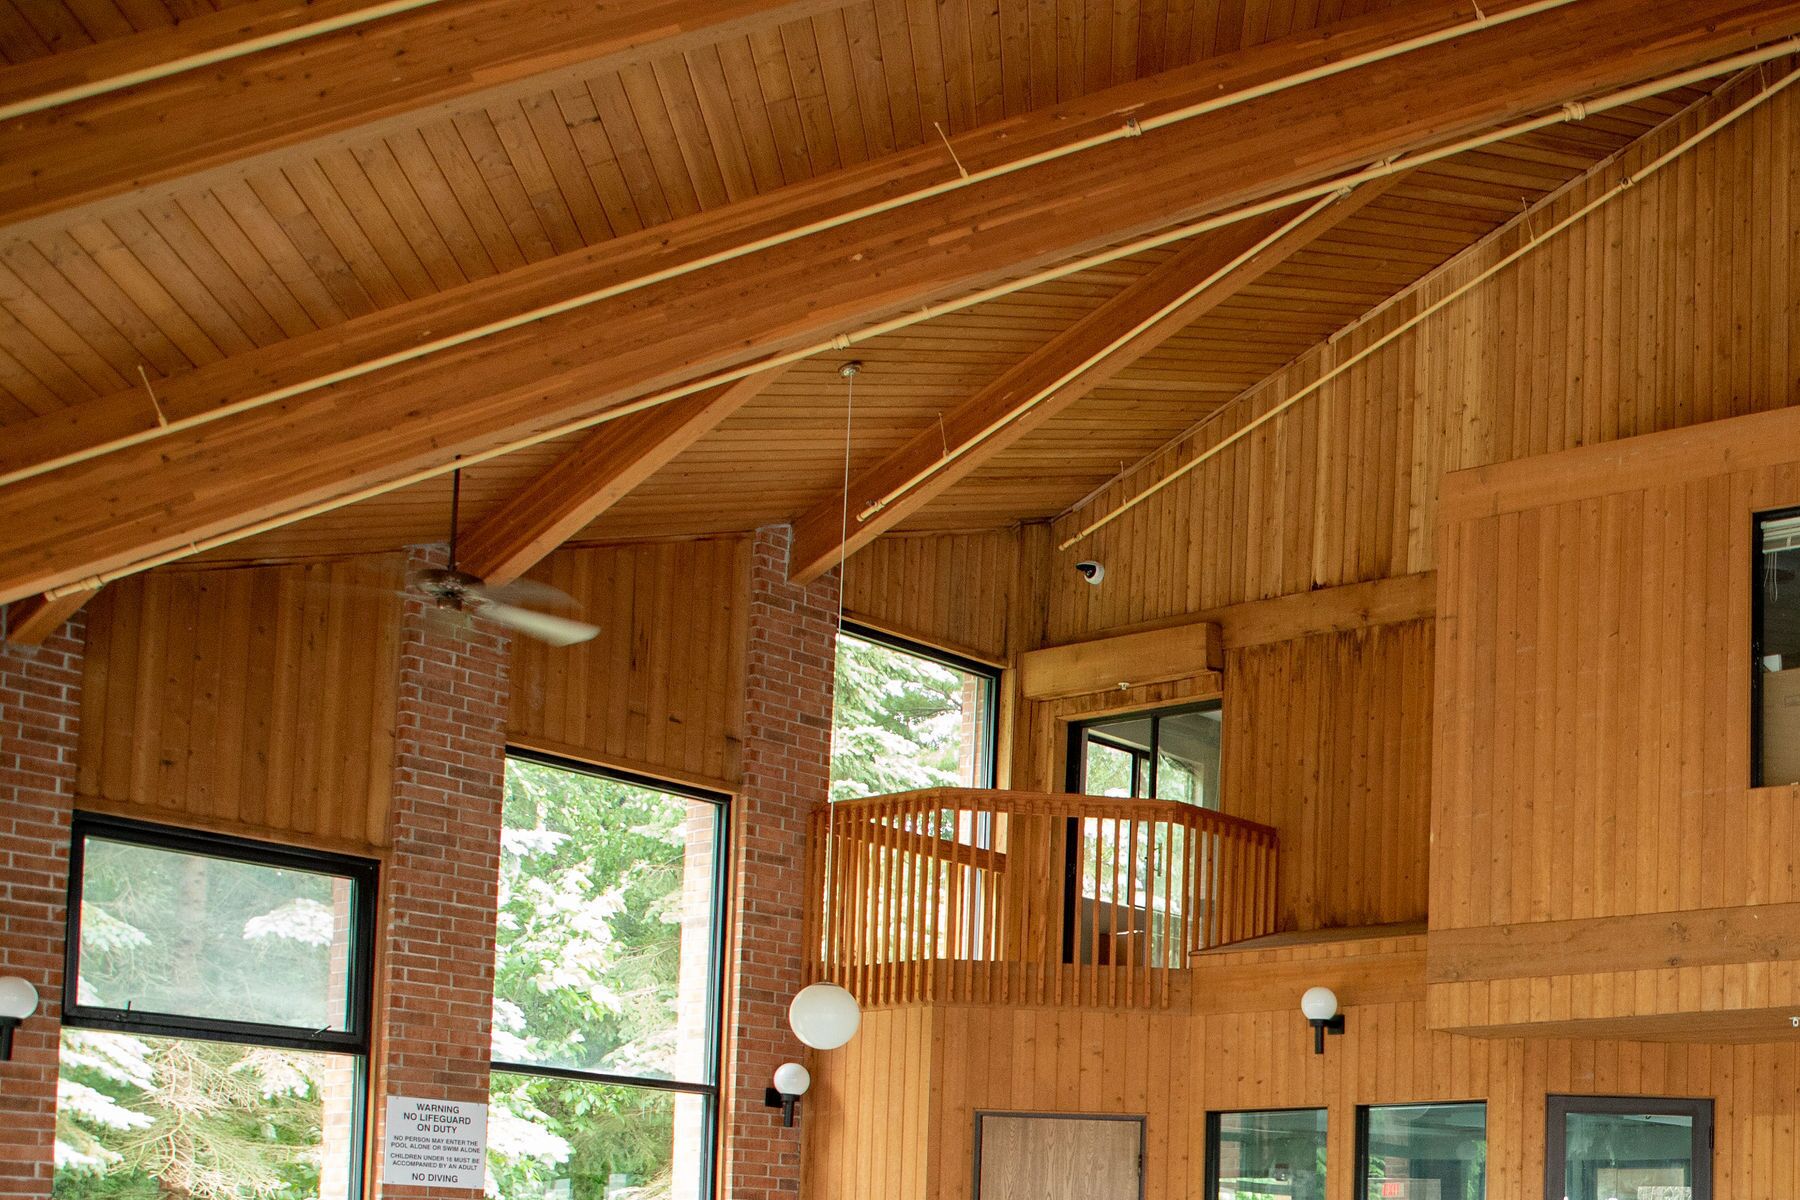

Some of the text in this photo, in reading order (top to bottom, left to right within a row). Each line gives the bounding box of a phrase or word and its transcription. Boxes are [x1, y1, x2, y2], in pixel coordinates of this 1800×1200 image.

[416, 1103, 460, 1114] WARNING
[403, 1112, 471, 1125] NO LIFEGUARD
[417, 1124, 457, 1133] ON DUTY
[412, 1173, 458, 1183] NO DIVING
